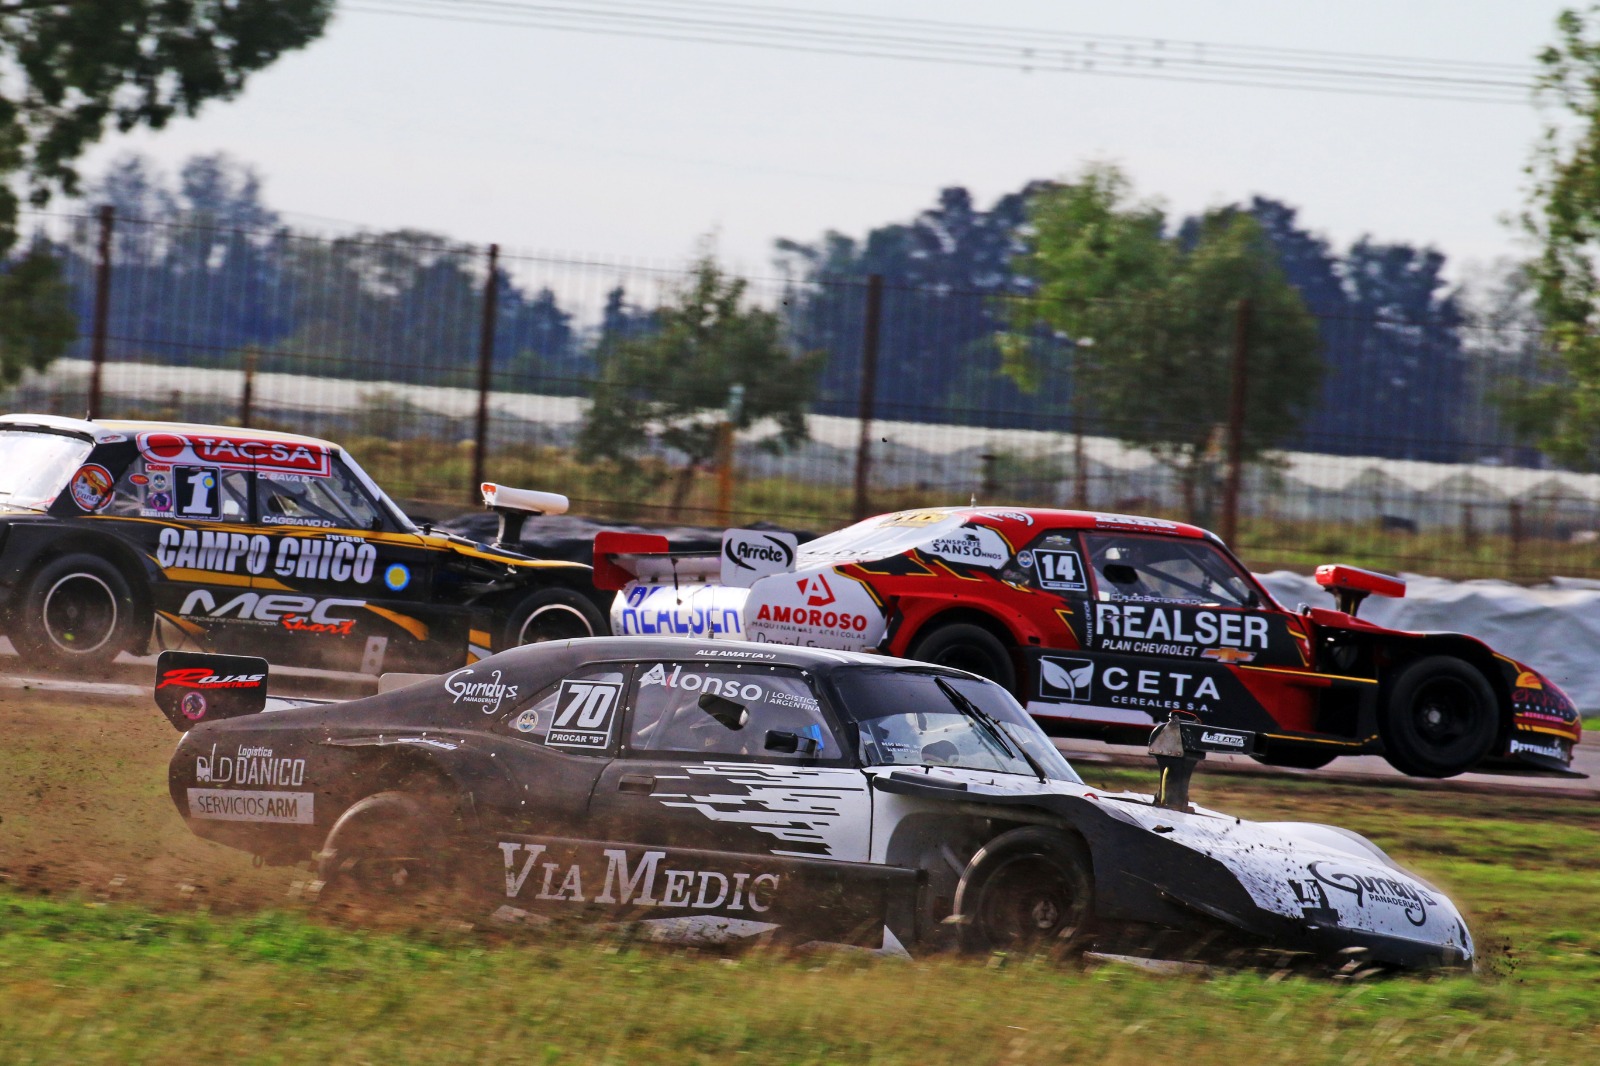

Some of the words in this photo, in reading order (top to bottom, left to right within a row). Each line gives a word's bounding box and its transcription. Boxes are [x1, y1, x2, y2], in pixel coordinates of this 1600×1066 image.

[198, 438, 316, 464] TACSA
[271, 473, 299, 481] BAVA
[182, 471, 213, 514] 1
[262, 515, 320, 527] CAGGIANO
[326, 534, 366, 543] FUTBOL
[156, 527, 270, 575] CAMPO
[274, 537, 377, 584] CHICO
[737, 541, 783, 562] Arrate
[933, 543, 982, 557] SANSO
[1042, 554, 1076, 580] 14
[757, 604, 867, 632] AMOROSO
[1096, 603, 1268, 649] REALSER
[1101, 638, 1132, 650] PLAN
[1133, 642, 1198, 657] CHEVROLET
[156, 668, 266, 689] ROJAS
[201, 681, 260, 689] COMPETICION
[638, 663, 763, 700] Alonso
[1102, 667, 1221, 700] CETA
[462, 696, 498, 704] PANADERIAS
[553, 684, 617, 729] 70
[769, 698, 821, 713] ARGENTINA
[772, 691, 819, 706] LOGISTICS
[1111, 695, 1181, 709] CEREALES
[1186, 702, 1214, 713] S.A.
[551, 733, 587, 743] PROCAR
[238, 744, 273, 758] Logistica
[235, 757, 306, 786] DANICO
[498, 842, 585, 902] VIA
[595, 849, 780, 912] MEDIC
[1368, 893, 1422, 911] PANADERIAS
